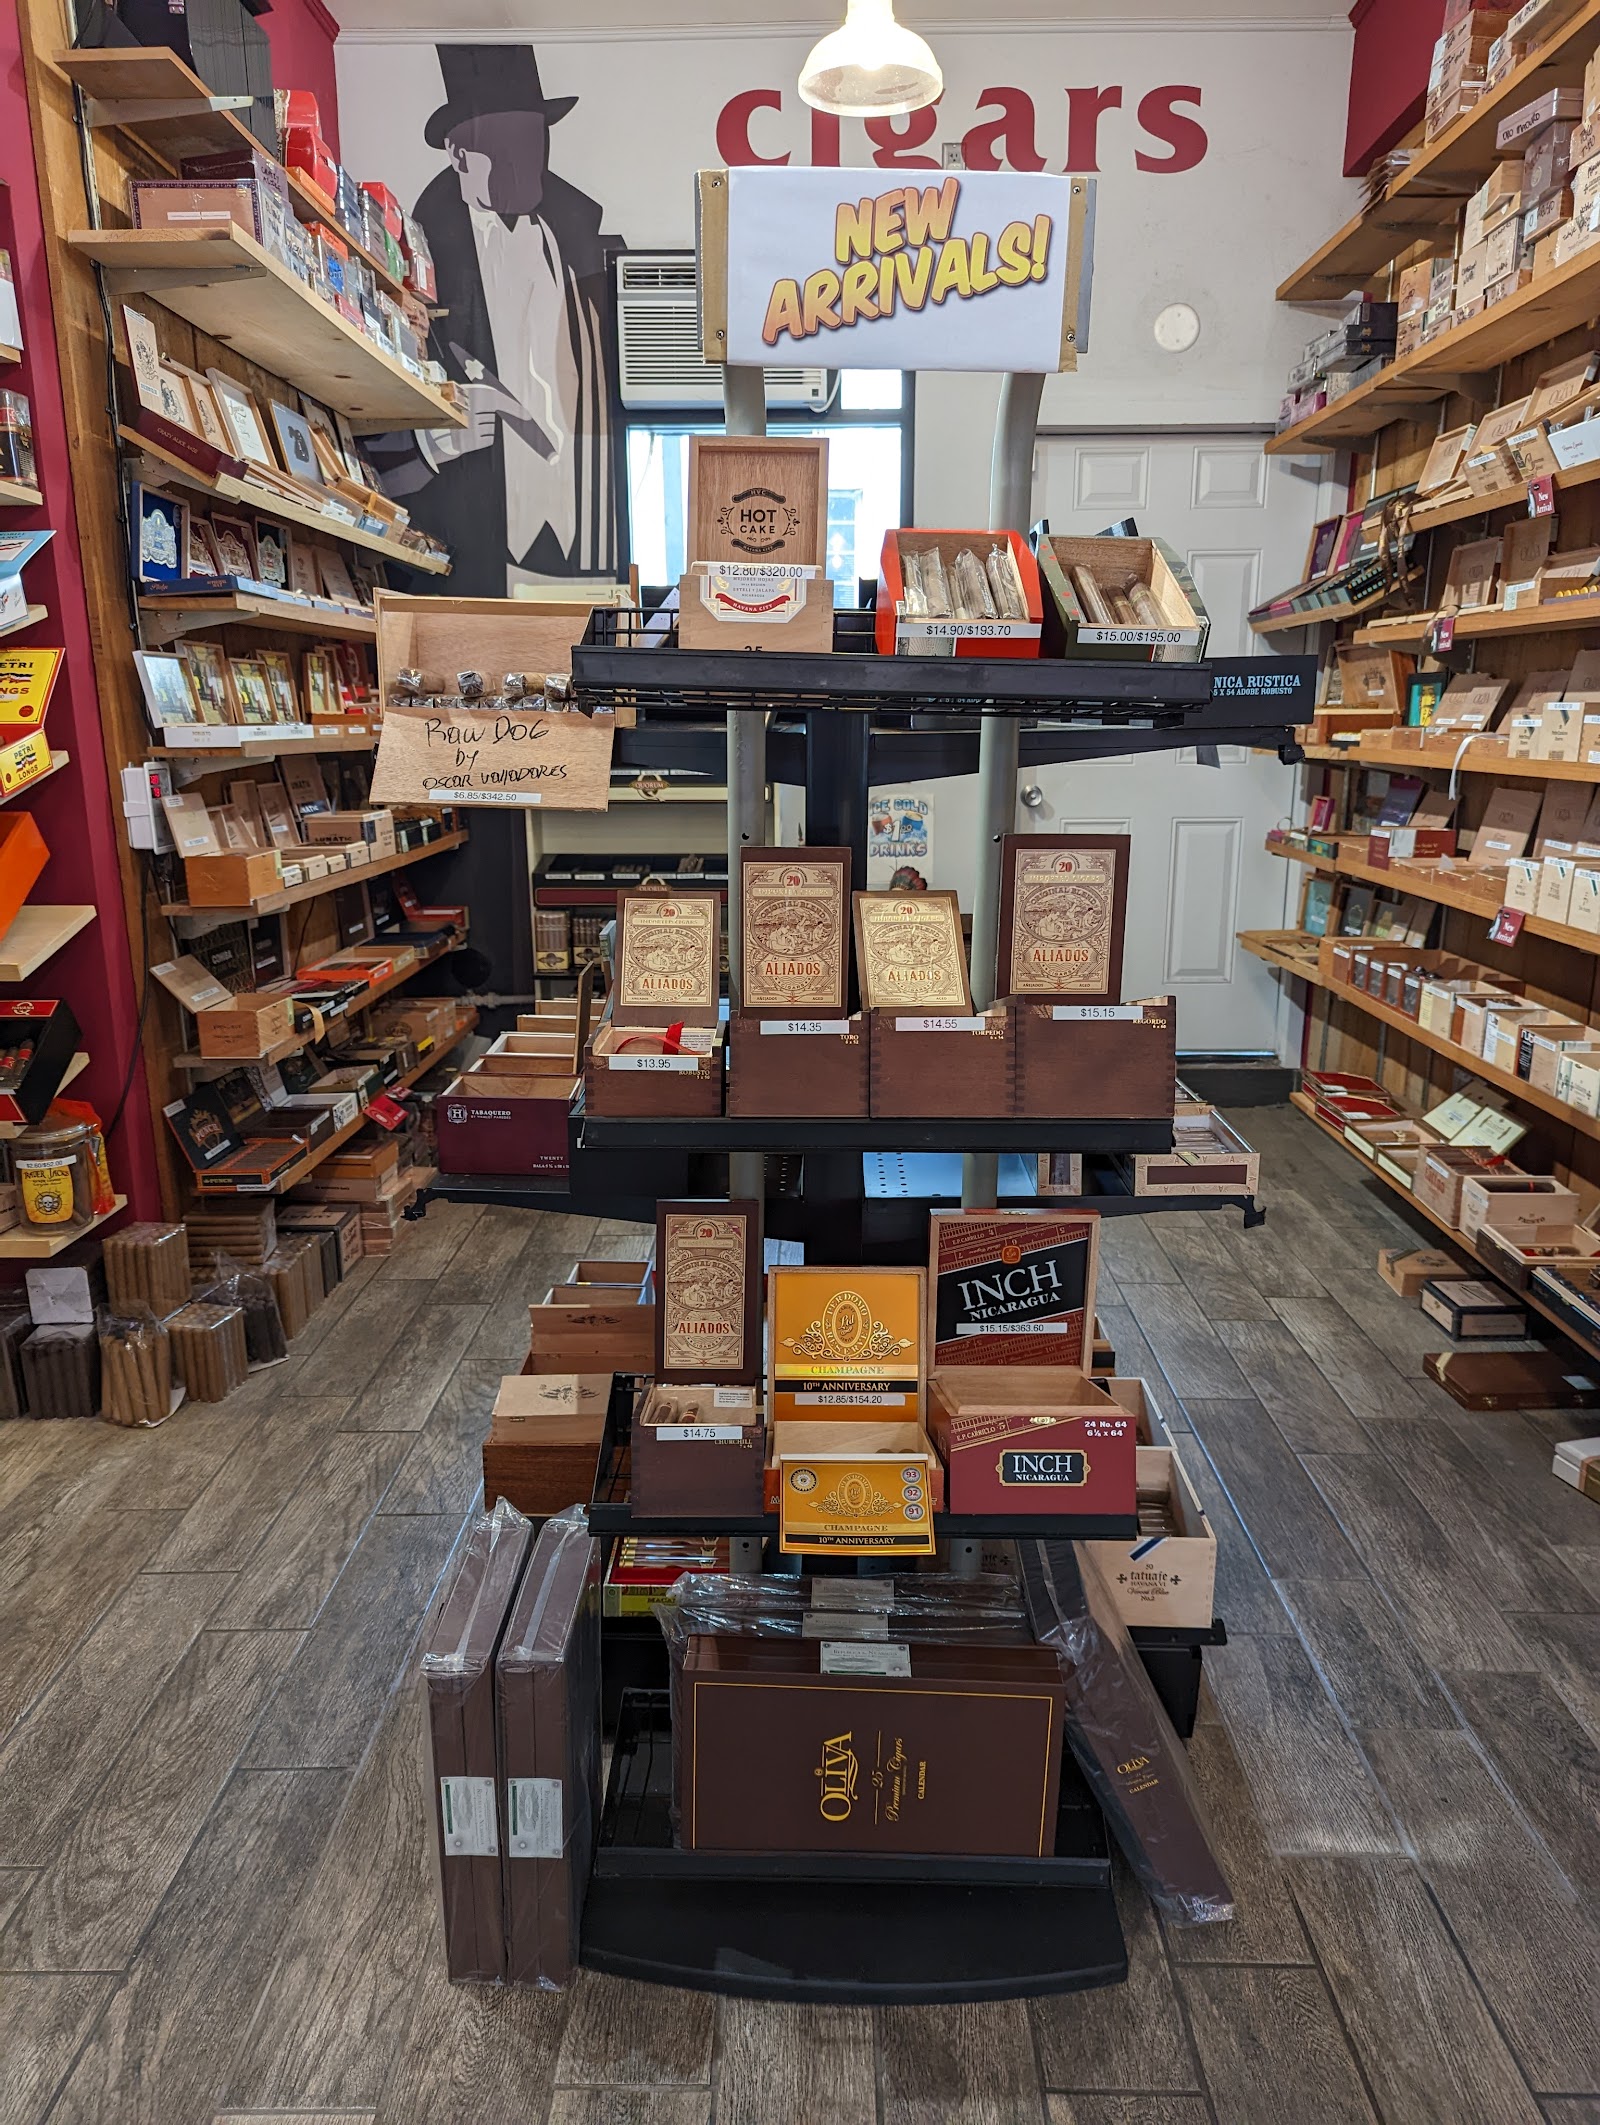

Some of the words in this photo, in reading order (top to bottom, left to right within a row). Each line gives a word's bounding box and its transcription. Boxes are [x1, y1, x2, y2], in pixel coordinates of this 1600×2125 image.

[715, 84, 1210, 174] cigars
[833, 176, 961, 266] NEW
[761, 213, 1054, 346] ARRIVALS!
[1538, 491, 1549, 502] New
[1536, 502, 1553, 514] Arrival
[740, 508, 777, 523] HOT
[739, 524, 776, 534] CAKE
[719, 564, 803, 578] $12.80/$320.00
[732, 602, 758, 612] HAVANA
[758, 603, 774, 612] CITY
[926, 622, 1011, 637] $14.90/$193.70
[1096, 630, 1181, 644] $15.00/$195.00
[1213, 675, 1244, 689] NICA
[1246, 673, 1301, 689] RUSTICA
[1236, 688, 1259, 696] ADOBE
[1260, 687, 1293, 696] ROBUSTO
[13, 745, 34, 760] PETRI
[18, 765, 39, 781] LONGS
[634, 781, 665, 789] QUORUM
[453, 791, 517, 802] $6.85/$342.50
[869, 799, 890, 816] ICE
[893, 798, 929, 816] COLD
[869, 842, 928, 858] DRINKS
[1058, 861, 1073, 873] 20
[786, 875, 801, 887] 20
[1070, 886, 1097, 905] BLEND
[662, 907, 676, 918] 20
[760, 900, 799, 919] ORIGINAL
[800, 901, 826, 919] BLEND
[899, 906, 913, 915] 20
[638, 928, 673, 944] ORIGINAL
[673, 929, 699, 944] BLEND
[1032, 949, 1089, 962] ALIADOS
[765, 962, 821, 976] ALIADOS
[887, 970, 942, 982] ALIADOS
[641, 978, 694, 990] ALIADOS
[1080, 1008, 1115, 1018] $15.15
[787, 1022, 822, 1032] $14.35
[923, 1019, 958, 1029] $14.55
[637, 1058, 671, 1069] $13.95
[451, 1108, 463, 1119] H
[196, 1122, 220, 1141] PUNCH
[674, 1260, 711, 1277] ORIGINAL
[711, 1260, 737, 1277] BLEND
[957, 1258, 1063, 1311] INCH
[826, 1293, 868, 1316] PERDOMO
[968, 1290, 1062, 1322] NICARAGUA
[678, 1322, 730, 1334] ALIADOS
[979, 1324, 1044, 1332] $15.15/$363.60
[826, 1331, 868, 1355] RESERVE
[810, 1365, 885, 1375] CHAMPAGNE
[822, 1381, 891, 1392] ANNIVERSARY
[818, 1394, 883, 1405] $12.85/$154.20
[683, 1428, 716, 1439] $14.75
[714, 1438, 753, 1446] CHURCHILL
[1012, 1455, 1073, 1473] INCH
[1015, 1473, 1070, 1482] NICARAGUA
[907, 1489, 919, 1497] 92
[908, 1507, 920, 1515] 91
[823, 1524, 889, 1532] CHAMPAGNE
[835, 1536, 896, 1545] ANNIVERSARY
[1130, 1571, 1168, 1583] tatuaje
[1116, 1756, 1150, 1775] OLIVA
[820, 1730, 855, 1822] OLIVA
[871, 1770, 884, 1789] 25
[917, 1760, 927, 1800] CALENDAR
[1129, 1778, 1160, 1794] CALENDAR
